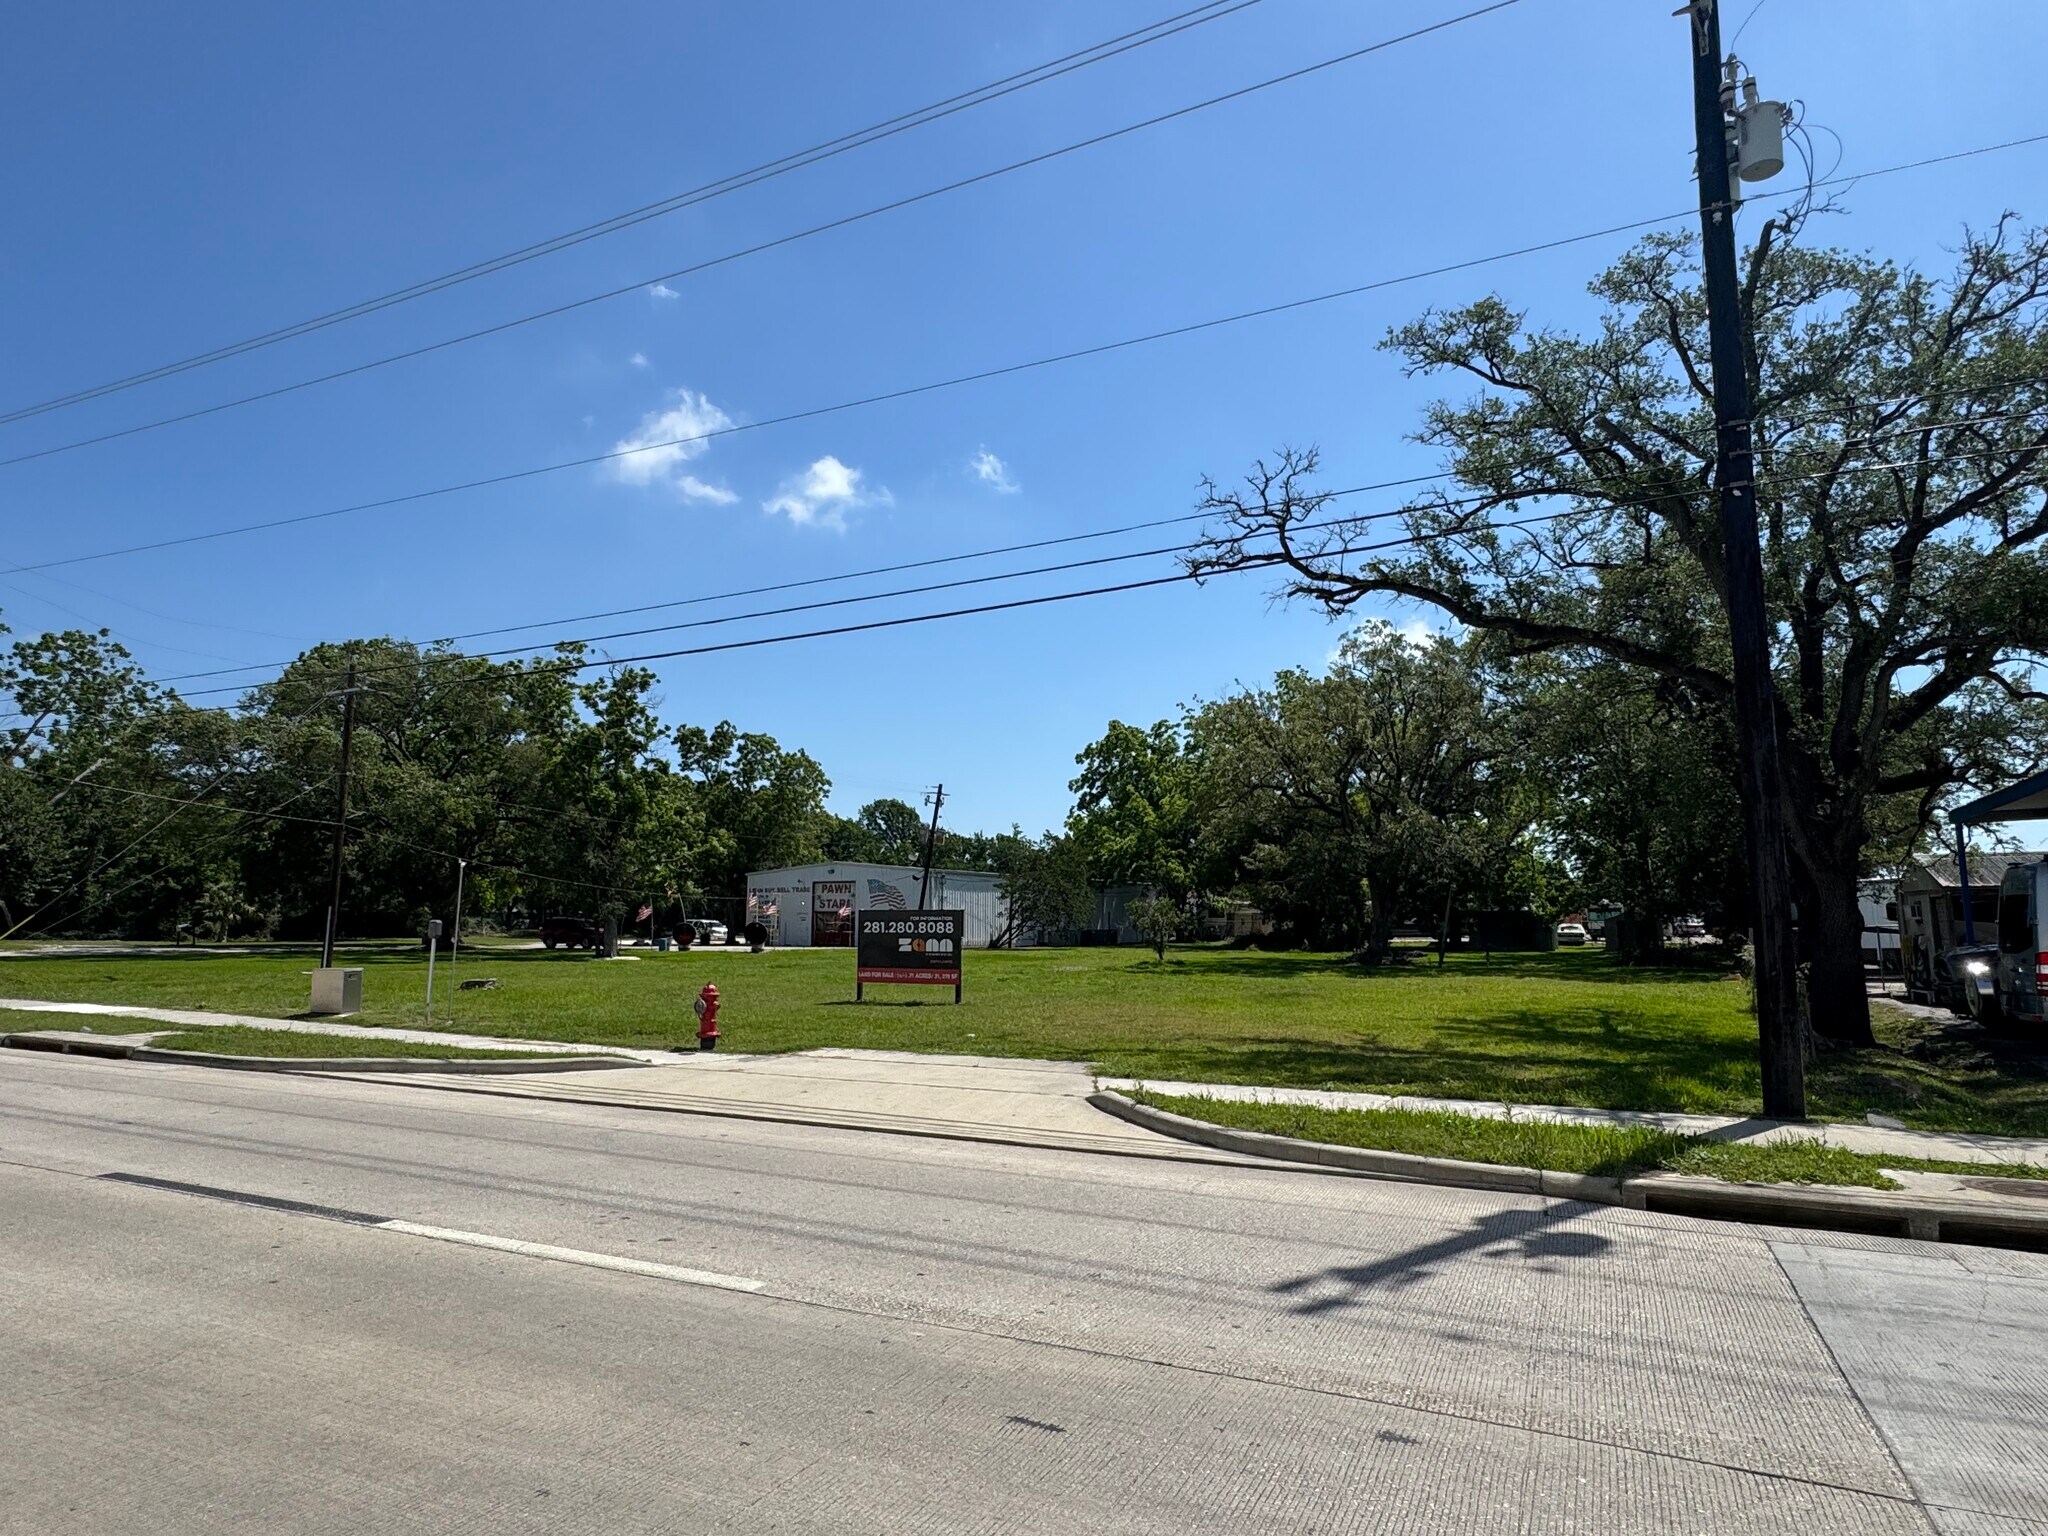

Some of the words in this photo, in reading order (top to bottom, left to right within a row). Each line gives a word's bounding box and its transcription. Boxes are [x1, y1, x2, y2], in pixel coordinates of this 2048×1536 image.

[821, 884, 852, 894] PAWN
[819, 898, 851, 909] STAR
[863, 921, 954, 934] 281.280.8088
